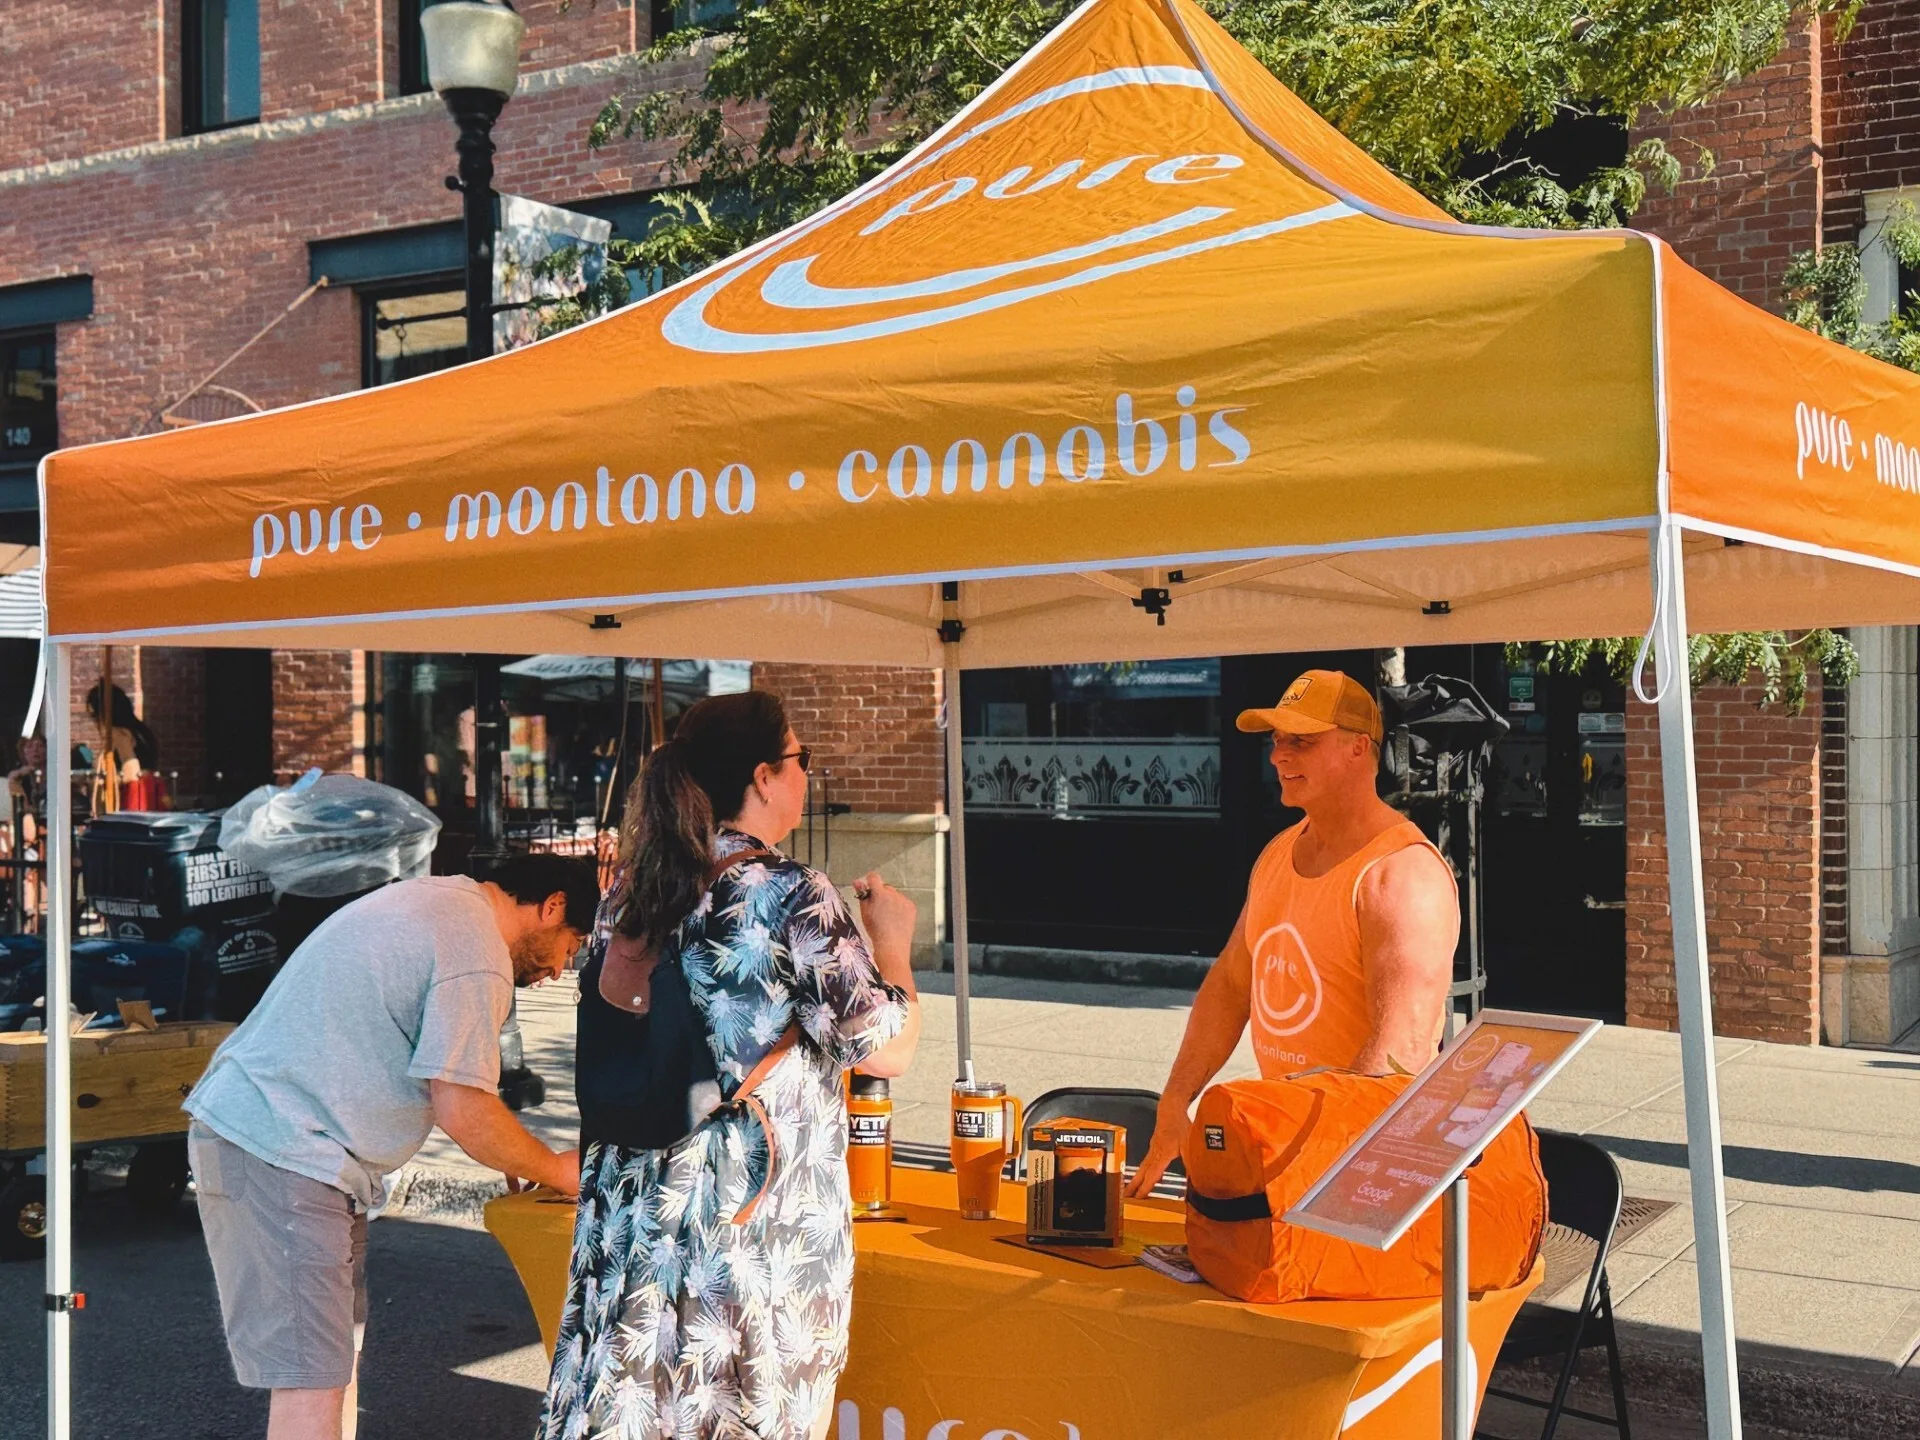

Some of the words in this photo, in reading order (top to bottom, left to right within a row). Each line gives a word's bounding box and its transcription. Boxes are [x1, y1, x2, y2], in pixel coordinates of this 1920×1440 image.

[858, 154, 1244, 236] pure
[1795, 400, 1854, 480] pure
[249, 504, 382, 578] pure
[445, 463, 756, 541] montana
[837, 385, 1251, 503] cannabis
[186, 862, 227, 884] FIRST
[186, 888, 210, 907] 100
[212, 882, 258, 903] LEATHER
[850, 1116, 886, 1130] YETI
[955, 1111, 983, 1125] YETI
[1056, 1134, 1106, 1144] JETBOIL
[1357, 1180, 1394, 1202] Google
